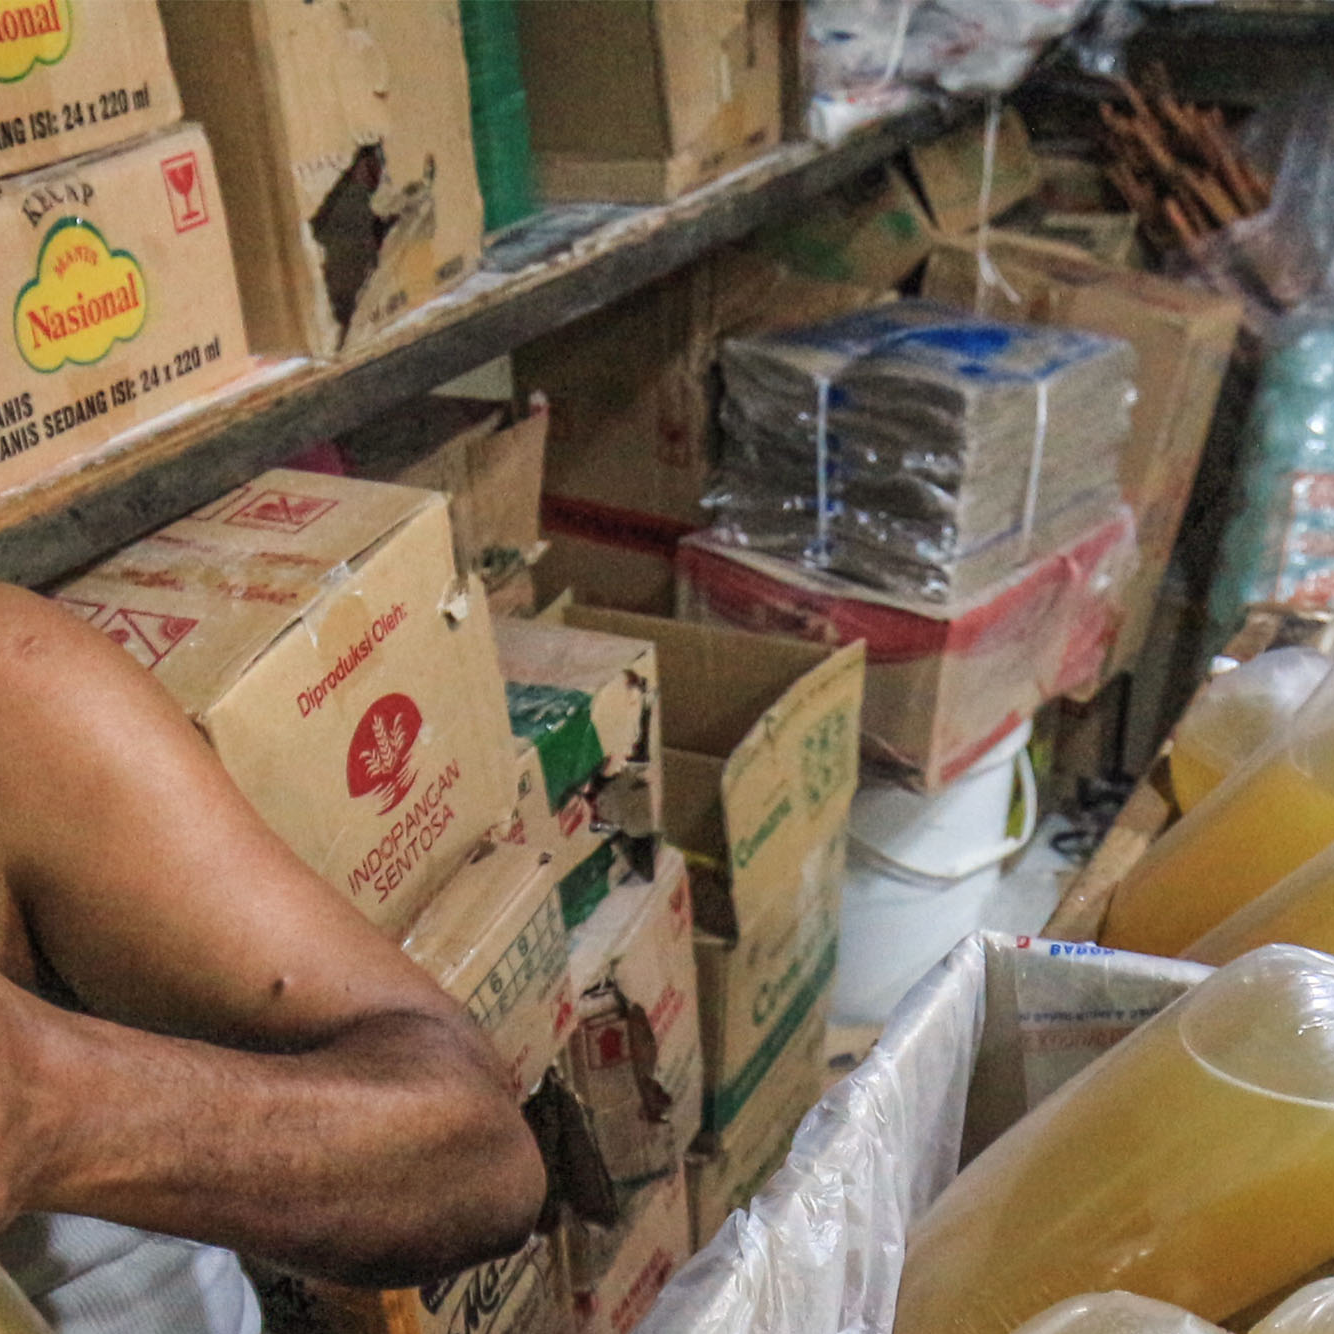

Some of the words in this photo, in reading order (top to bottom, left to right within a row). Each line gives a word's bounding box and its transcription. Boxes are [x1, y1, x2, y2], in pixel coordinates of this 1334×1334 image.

[30, 112, 58, 140] ISI:
[63, 102, 85, 131] 24
[99, 88, 128, 120] 220
[27, 272, 140, 349] Nasional
[42, 391, 108, 438] SEDANG
[110, 378, 136, 406] ISI:
[140, 364, 160, 392] 24
[174, 346, 202, 376] 220
[297, 631, 373, 719] Diproduksi
[372, 602, 408, 643] Oleh:
[347, 758, 460, 896] INDOPANGAN
[373, 804, 455, 903] SENTOSA
